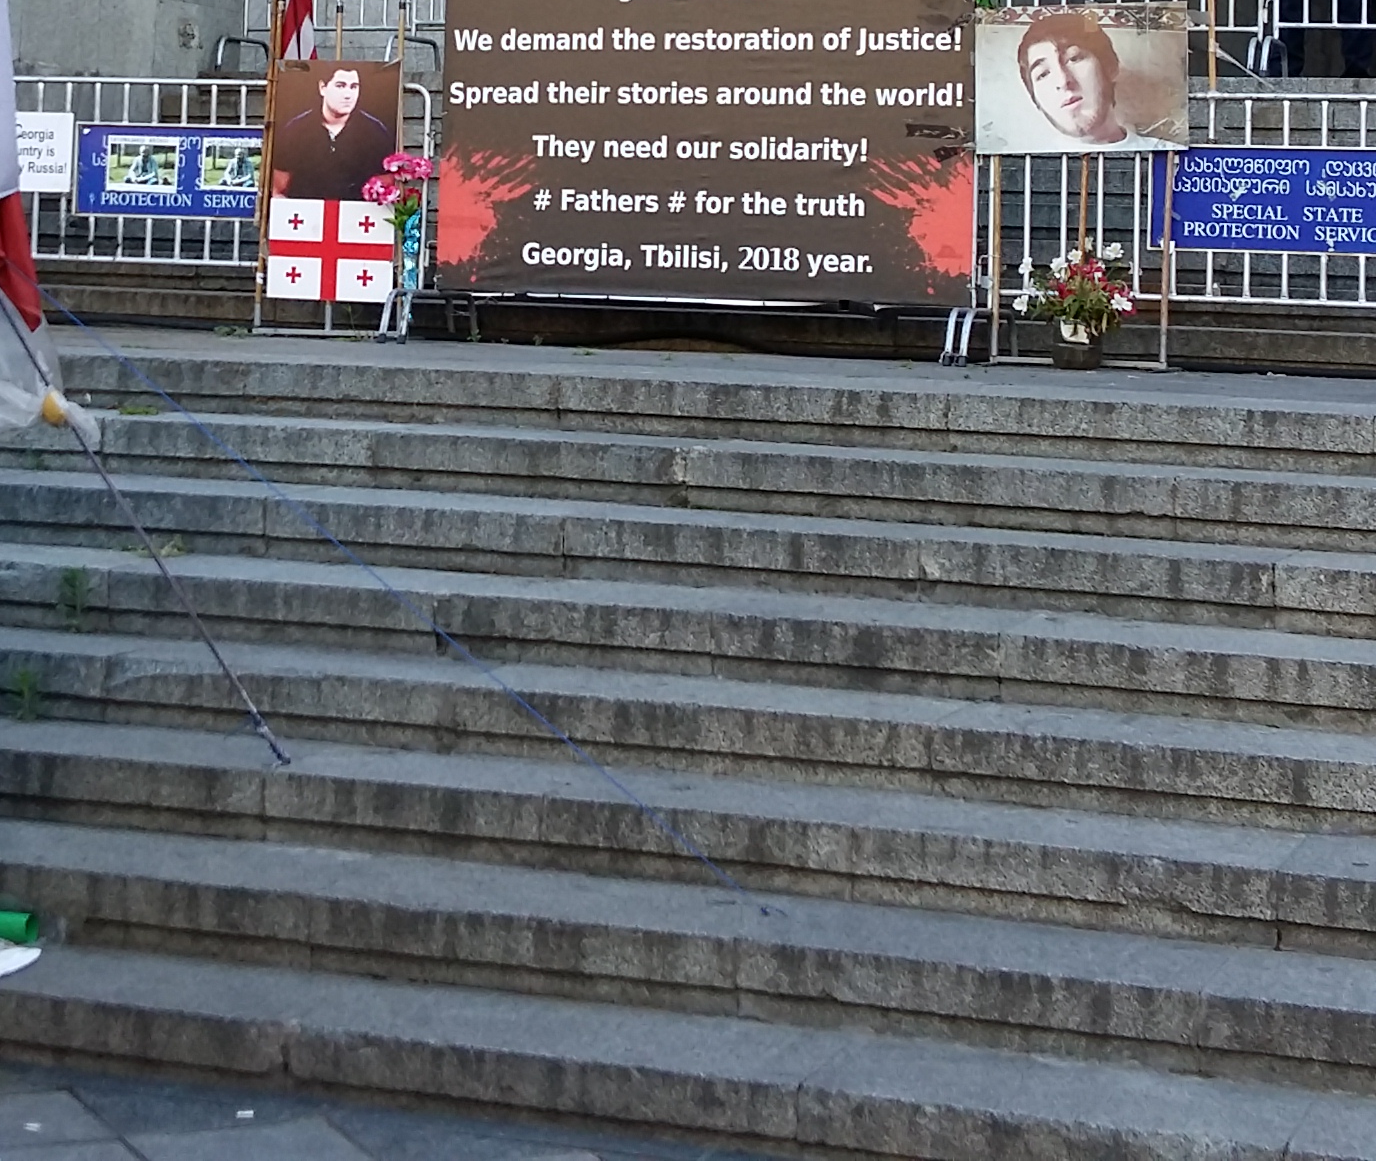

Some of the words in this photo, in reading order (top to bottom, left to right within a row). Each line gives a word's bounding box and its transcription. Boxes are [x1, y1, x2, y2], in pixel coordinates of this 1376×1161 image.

[454, 29, 492, 50] We
[501, 28, 603, 50] demand
[612, 28, 655, 50] the
[665, 27, 813, 50] restoration
[823, 27, 851, 50] of
[856, 27, 961, 55] Justice!
[450, 81, 539, 109] Spread
[547, 81, 610, 103] their
[618, 81, 707, 104] stories
[716, 82, 811, 105] around
[820, 83, 866, 105] the
[876, 83, 962, 106] world!
[18, 146, 42, 159] untry
[47, 146, 55, 156] is
[532, 135, 595, 162] They
[604, 135, 667, 158] need
[677, 141, 722, 158] our
[730, 137, 867, 166] solidarity!
[28, 162, 66, 173] Russia!
[1184, 157, 1309, 174] სახელმწიფო
[1173, 177, 1290, 194] სპეციალური
[101, 193, 192, 208] PROTECTION
[204, 194, 258, 209] SERVIC
[534, 189, 551, 210] #
[561, 189, 658, 212] Fathers
[668, 191, 686, 212] #
[695, 191, 734, 213] for
[742, 192, 786, 215] the
[795, 193, 864, 216] truth
[1211, 204, 1287, 221] SPECIAL
[1303, 207, 1363, 223] STATE
[1183, 222, 1300, 240] PROTECTION
[523, 242, 631, 271] Georgia,
[640, 245, 728, 272] Tbilisi,
[738, 247, 799, 271] 2018
[807, 254, 872, 277] year.
